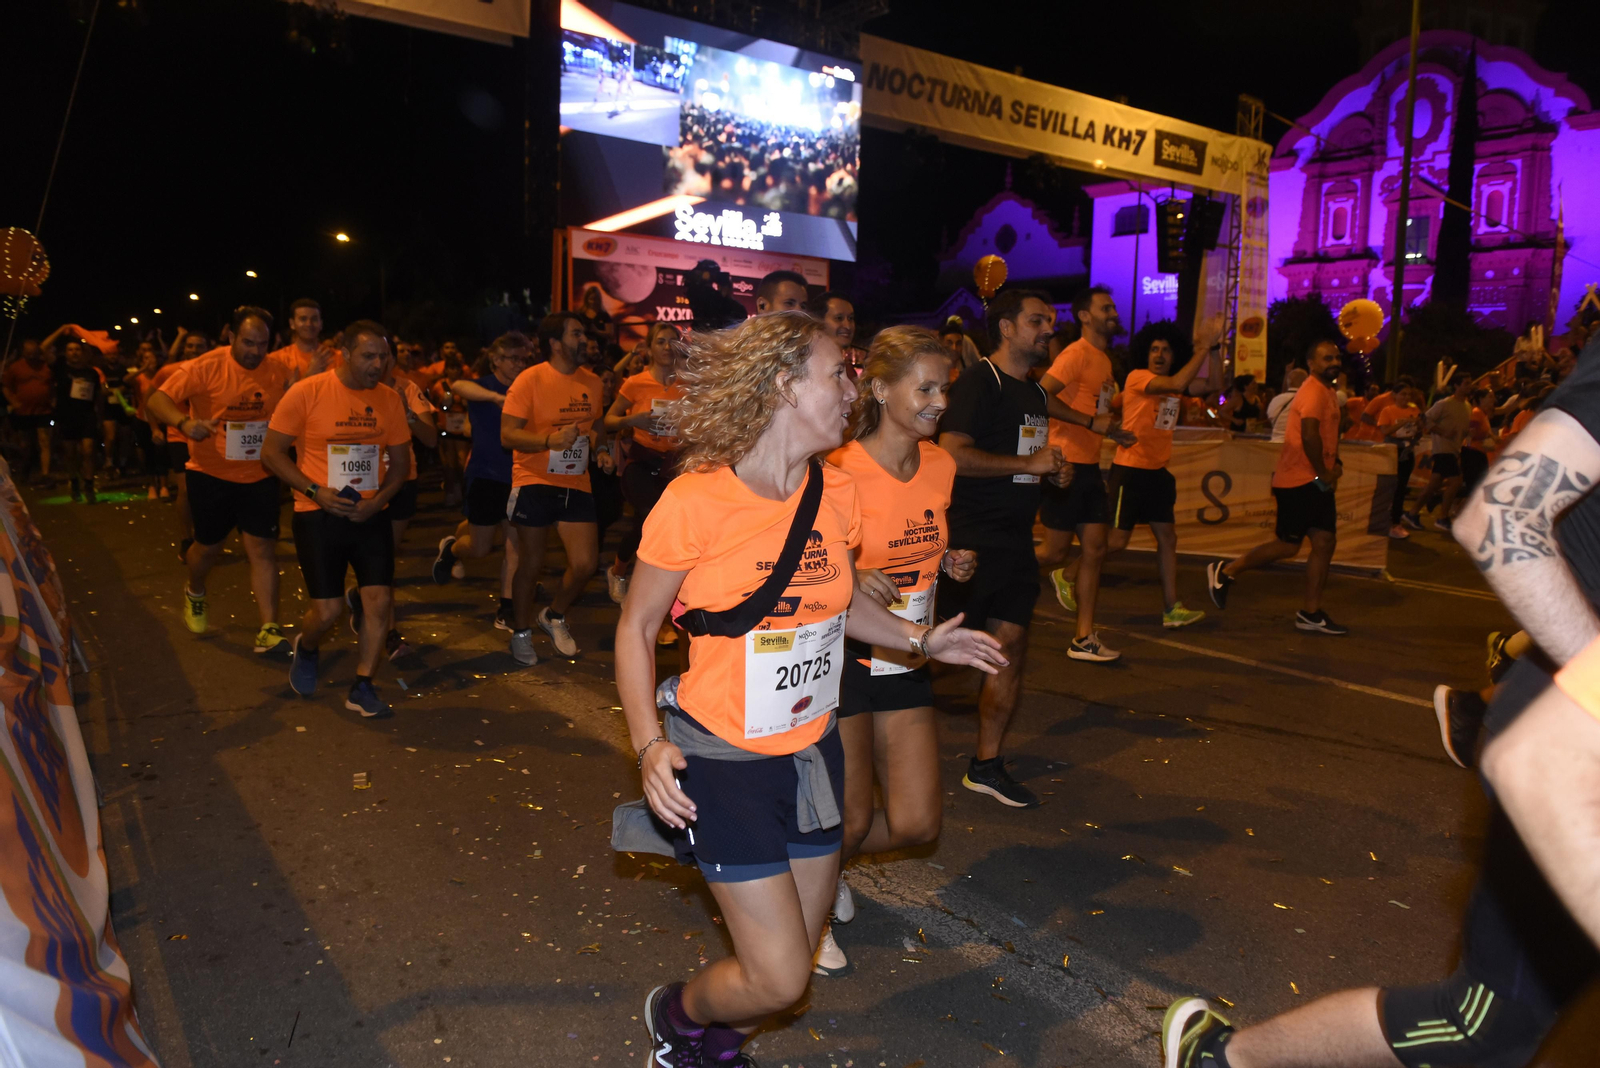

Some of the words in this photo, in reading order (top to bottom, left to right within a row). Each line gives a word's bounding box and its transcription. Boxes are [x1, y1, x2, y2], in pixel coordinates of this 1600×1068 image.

[867, 62, 1003, 120] NOCTURNA
[1009, 99, 1096, 143] SEVILLA
[241, 435, 263, 445] 3284
[562, 449, 583, 459] 6762
[341, 460, 372, 472] 10968
[904, 525, 939, 537] NOCTURNA
[888, 536, 922, 549] SEVILLA
[775, 651, 831, 691] 20725
